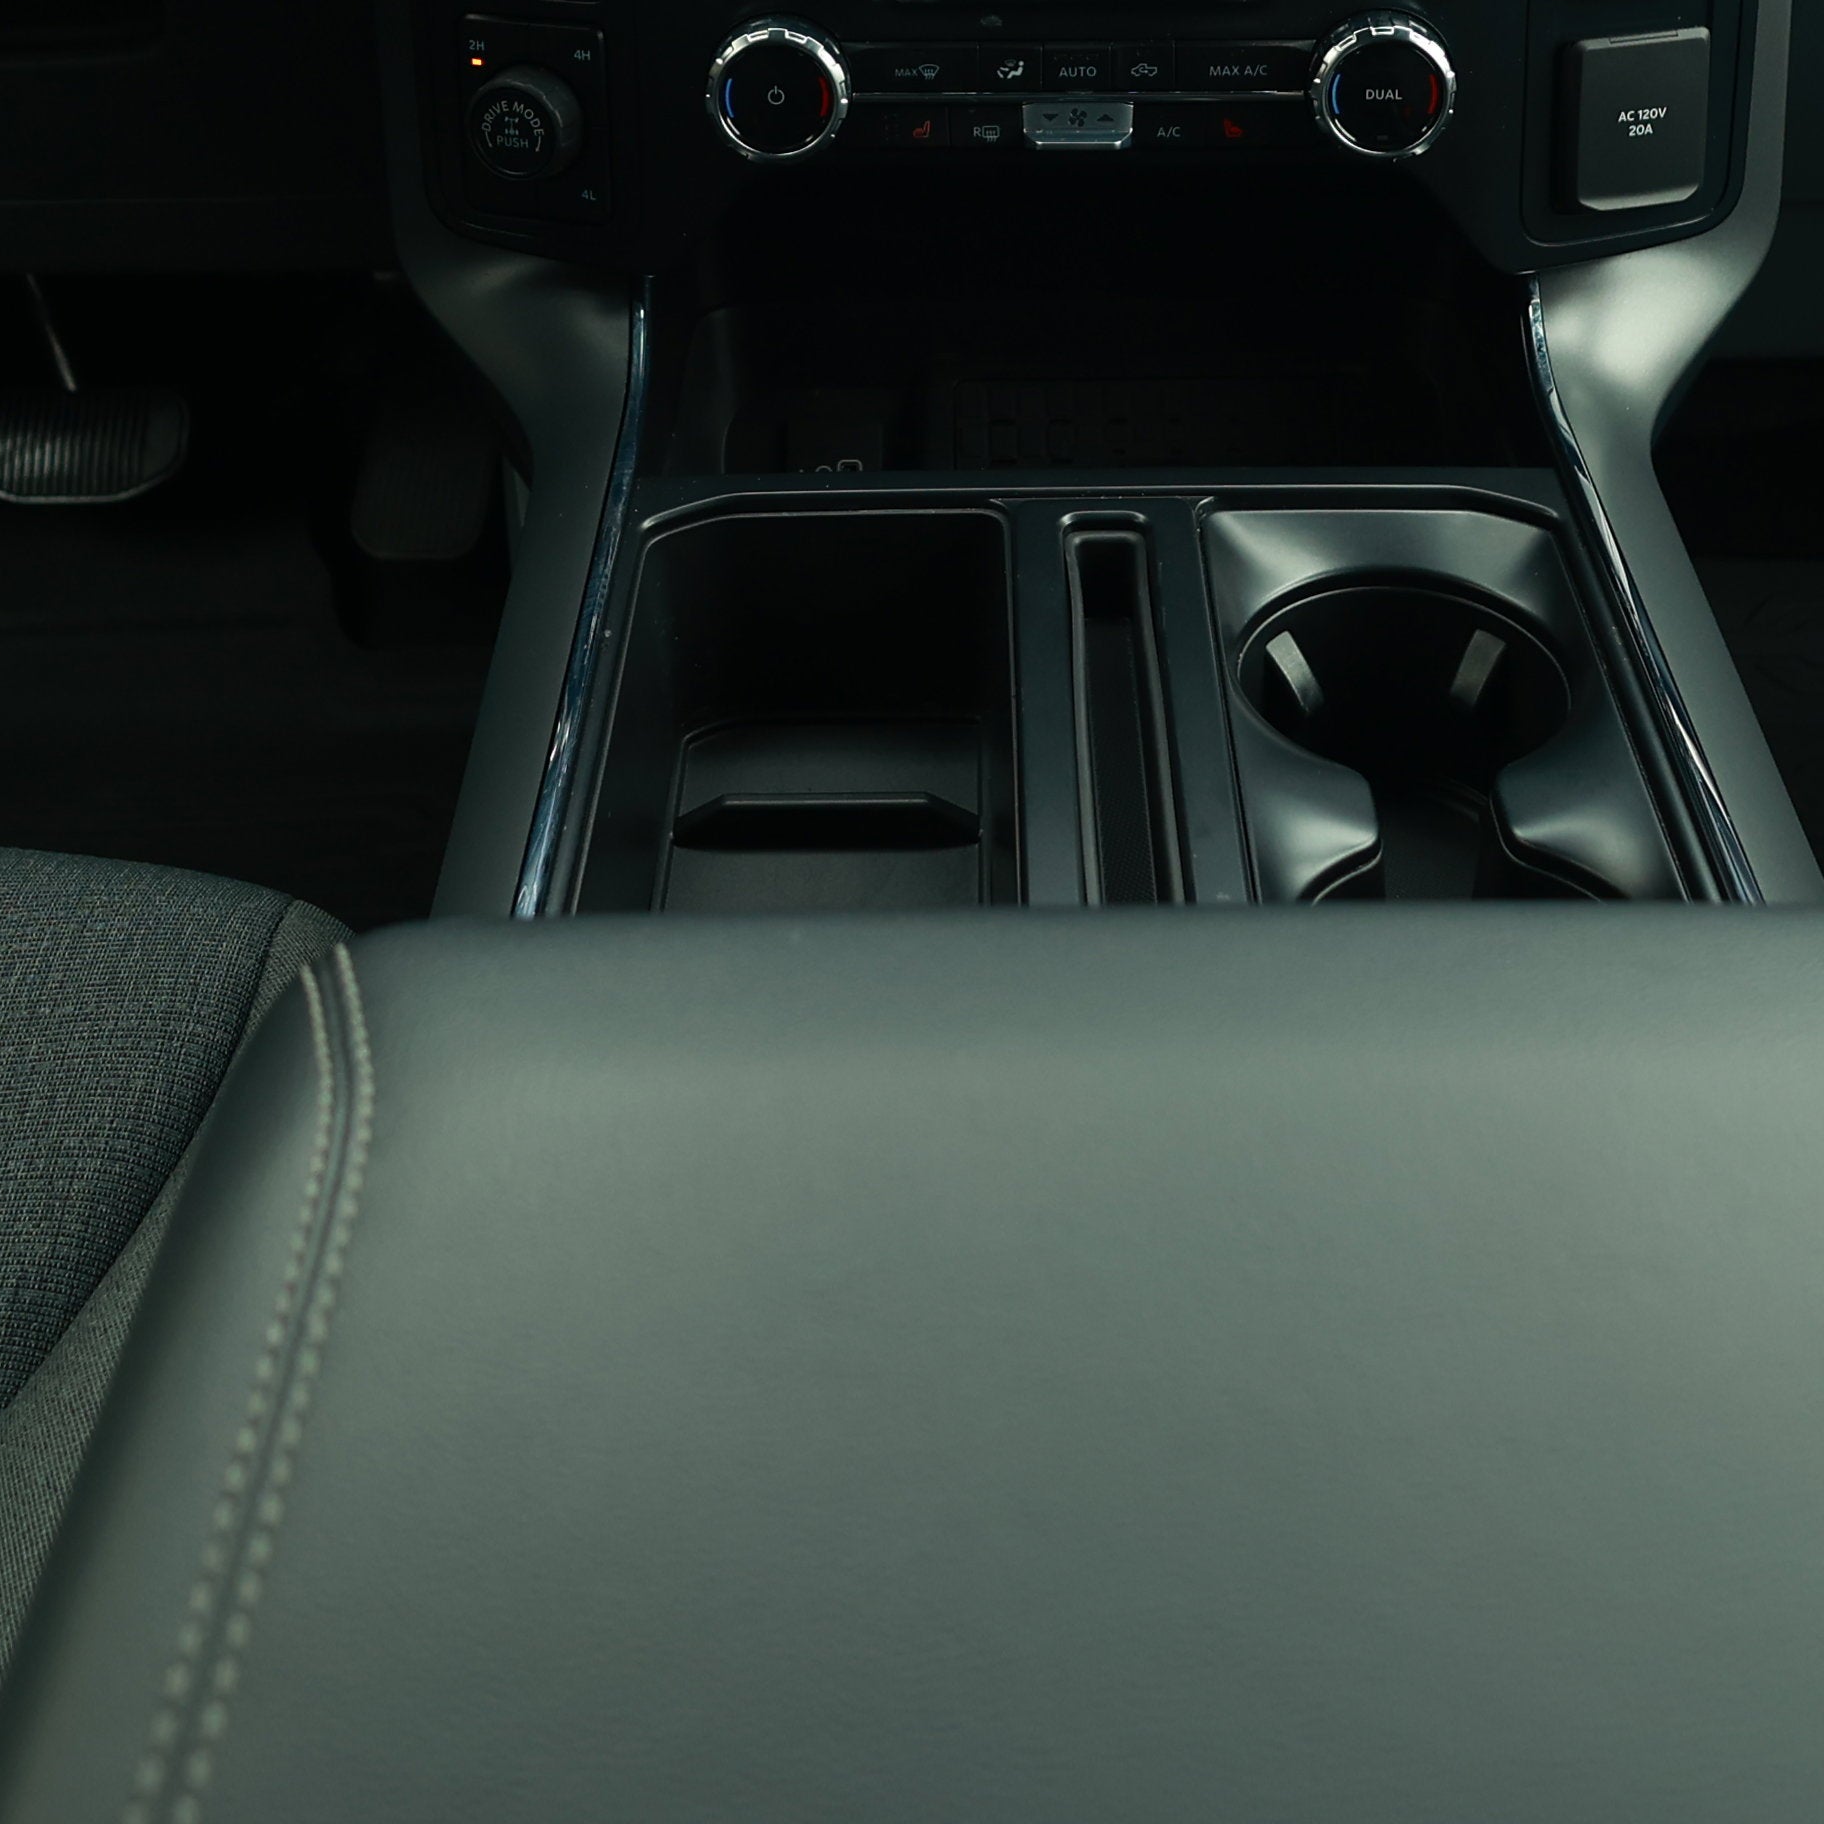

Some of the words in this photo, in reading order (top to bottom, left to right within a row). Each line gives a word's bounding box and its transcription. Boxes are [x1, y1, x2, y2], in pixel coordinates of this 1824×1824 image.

[468, 39, 485, 52] 2H
[573, 49, 591, 62] 4H
[894, 66, 918, 78] MAX
[1058, 65, 1097, 78] AUTO
[1209, 64, 1240, 77] MAX
[1243, 63, 1268, 77] A/C
[1365, 88, 1403, 101] DUAL
[481, 100, 509, 132] DRIVE
[512, 100, 545, 137] MODE
[1618, 110, 1635, 123] AC
[1637, 107, 1667, 121] 120V
[1157, 125, 1181, 138] A/C
[1628, 123, 1654, 136] 20A
[496, 134, 530, 149] PUSH
[581, 189, 597, 202] 4L
